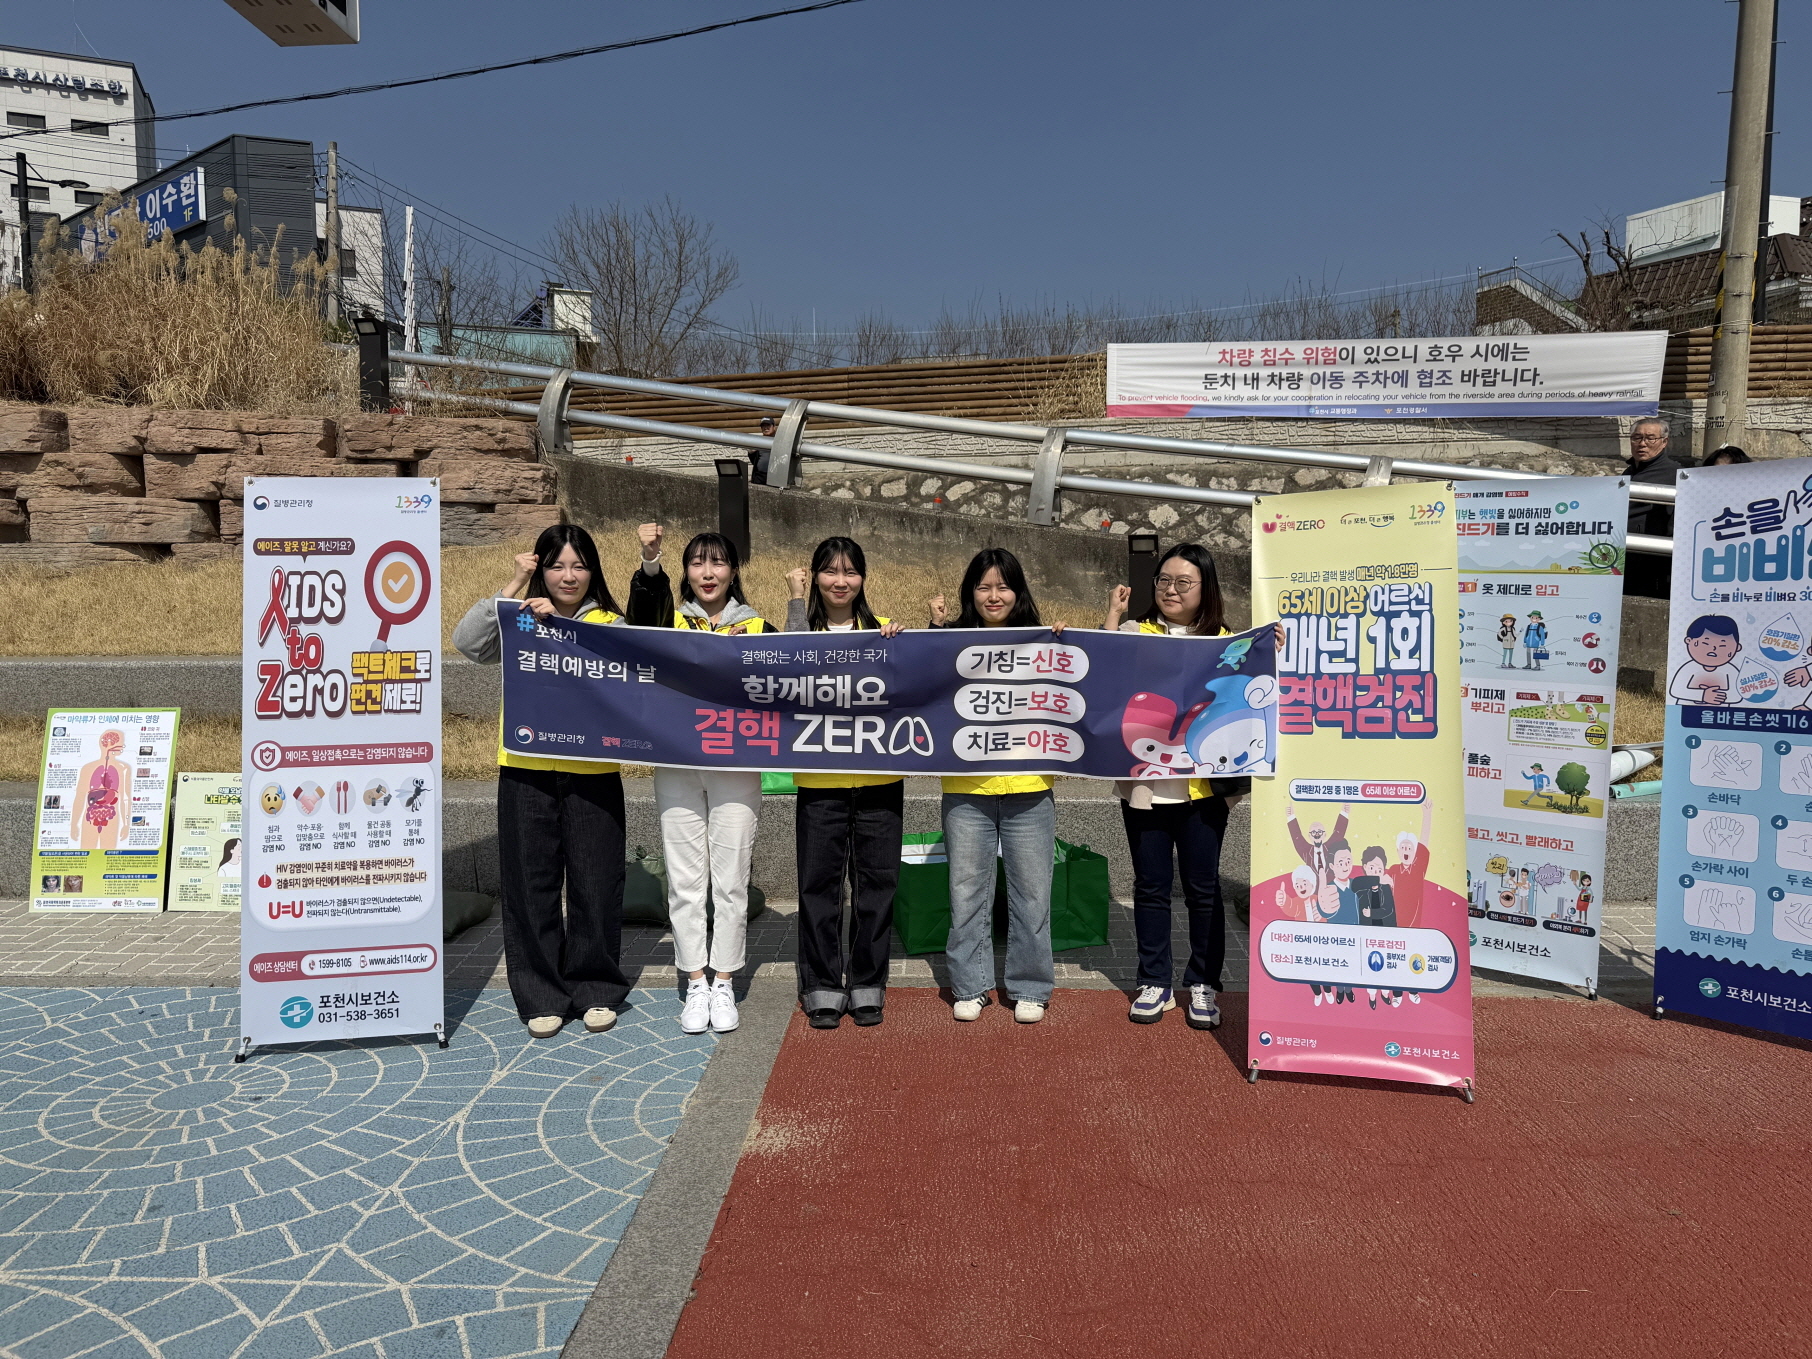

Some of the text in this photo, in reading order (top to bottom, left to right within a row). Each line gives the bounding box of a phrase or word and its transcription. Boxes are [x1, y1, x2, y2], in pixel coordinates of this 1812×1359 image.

[145, 172, 197, 219] 이수환
[183, 206, 193, 222] 1F
[1218, 342, 1530, 367] 차량 침수 위험이 있으니 호우 시에는
[1202, 367, 1544, 391] 둔치 내 차량 이동 주차에 협조 바랍니다.
[1128, 394, 1153, 403] prevent
[1181, 394, 1210, 403] flooding,
[1224, 394, 1244, 403] kindly
[1273, 395, 1289, 403] your
[1291, 394, 1333, 402] cooperation
[1344, 393, 1380, 402] relocating
[1382, 394, 1399, 402] your
[1429, 392, 1446, 400] from
[1462, 391, 1495, 399] riverside
[1518, 391, 1542, 400] during
[1545, 390, 1575, 399] periods
[1588, 390, 1613, 399] heavy
[273, 499, 313, 508] 질병관리청
[395, 494, 432, 509] 1339
[1409, 501, 1445, 520] 1339
[1479, 507, 1551, 520] 햇빛을 싫어하지만
[1711, 498, 1783, 541] 손을
[1457, 521, 1613, 536] 진드기를 더 싫어합니다
[257, 541, 352, 552] 에이즈, 잘못 알고 계신가요?
[1702, 525, 1812, 583] 비비
[1290, 565, 1375, 584] 우리나라 결핵 발생 매년
[1482, 583, 1559, 596] 옷 제대로 입고
[1710, 590, 1797, 603] 손을 비누로 비벼요
[1278, 582, 1432, 617] 65세 이상 어르신
[286, 626, 323, 670] to
[1279, 611, 1433, 675] 매년 1회
[1762, 636, 1799, 650] 20% 감소
[741, 648, 888, 665] 결핵없는 사회, 건강한 국가
[970, 648, 1075, 674] 기침=신호
[352, 650, 431, 682] 팩트체크로
[518, 650, 657, 683] 결핵예방의 날
[255, 660, 347, 720] Zero
[741, 674, 889, 709] 함께해요
[1471, 687, 1505, 701] 기피제
[1740, 677, 1776, 694] 30% 감소
[350, 682, 422, 714] 편견 제로!
[969, 689, 1072, 716] 검진=보호
[1279, 672, 1437, 739] 결핵검진
[1470, 701, 1505, 714] 뿌리고
[537, 731, 585, 745] 질병관리청
[694, 708, 781, 756] 결핵
[967, 729, 1072, 755] 치료=야호
[285, 747, 428, 762] 에이즈, 일상접촉으로는 감염되지 않습니다
[1468, 752, 1491, 766] 풀숲
[1467, 766, 1502, 780] 피하고
[1295, 784, 1359, 796] 결핵환자 2명 중 1명은
[1365, 786, 1417, 797] 65세 이상 어르신
[1707, 792, 1741, 805] 손바닥
[380, 839, 391, 847] NO
[1468, 827, 1574, 852] 털고, 씻고, 빨래하고
[276, 857, 414, 874] HIV 감염인이 치료약을 바이러스가
[1691, 861, 1749, 878] 손가락 사이
[276, 871, 427, 890] 검출되지 바이러스를 않습니다
[1786, 874, 1799, 886] 두
[268, 900, 304, 920] U=U
[1270, 932, 1356, 947] [대상] 65세 이상 어르신
[1365, 939, 1406, 950] [무료검진]
[1481, 936, 1551, 958] 포천시보건소
[1689, 930, 1748, 950] 엄지 손가락
[253, 960, 298, 974] 에이즈 상담센터
[318, 957, 352, 969] 1599-8105
[368, 953, 428, 967] www.aids114.or.kr
[1270, 953, 1349, 968] [장소] 포천시보건소
[318, 990, 400, 1009] 포천시보건소
[1726, 986, 1812, 1014] 포천시보건소
[318, 1008, 400, 1023] 031-538-3651
[1276, 1036, 1317, 1048] 질병관리청
[1403, 1047, 1460, 1060] 포천시보건소
